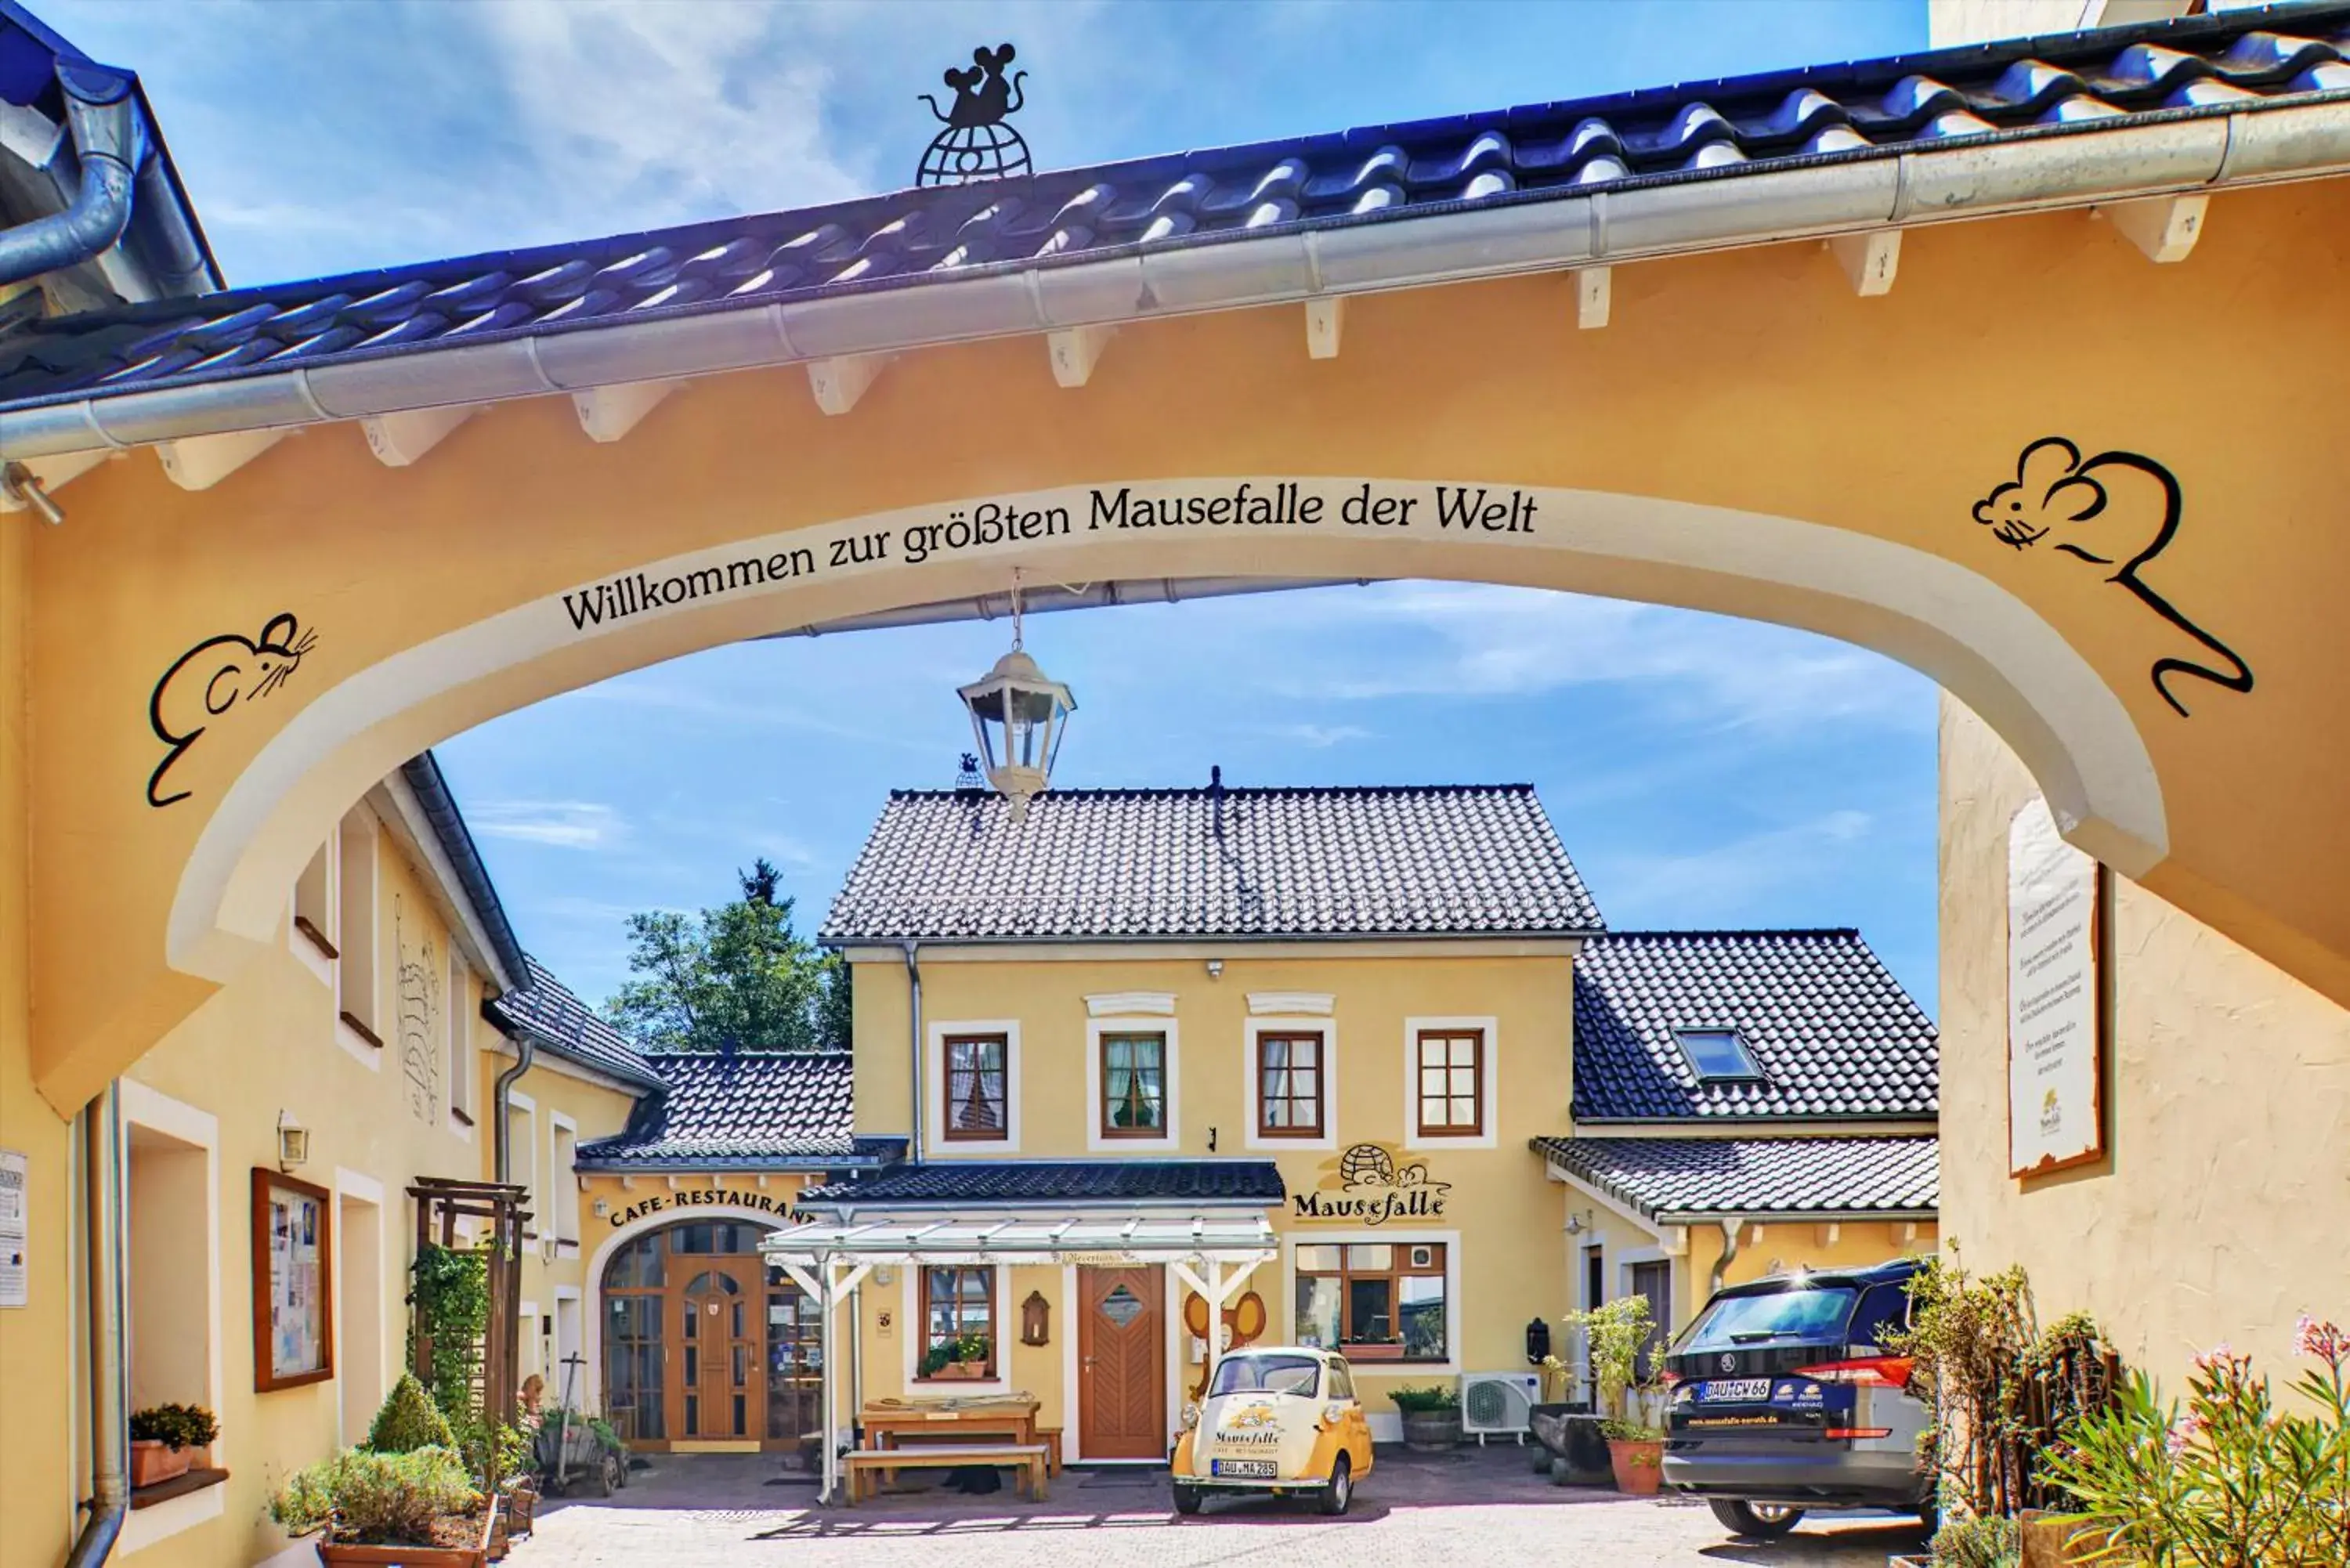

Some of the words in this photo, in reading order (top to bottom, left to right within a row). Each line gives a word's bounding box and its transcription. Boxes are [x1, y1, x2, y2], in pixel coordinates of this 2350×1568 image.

[562, 548, 815, 630] Willkommen
[829, 531, 891, 566] zur
[902, 504, 1072, 562] größten
[1088, 482, 1324, 530] Mausefalle
[1341, 483, 1417, 526] der
[1435, 486, 1538, 533] Welt
[1292, 1190, 1446, 1226] Mausefalle
[1752, 1380, 1767, 1395] 66
[1216, 1432, 1278, 1445] Mausefalle
